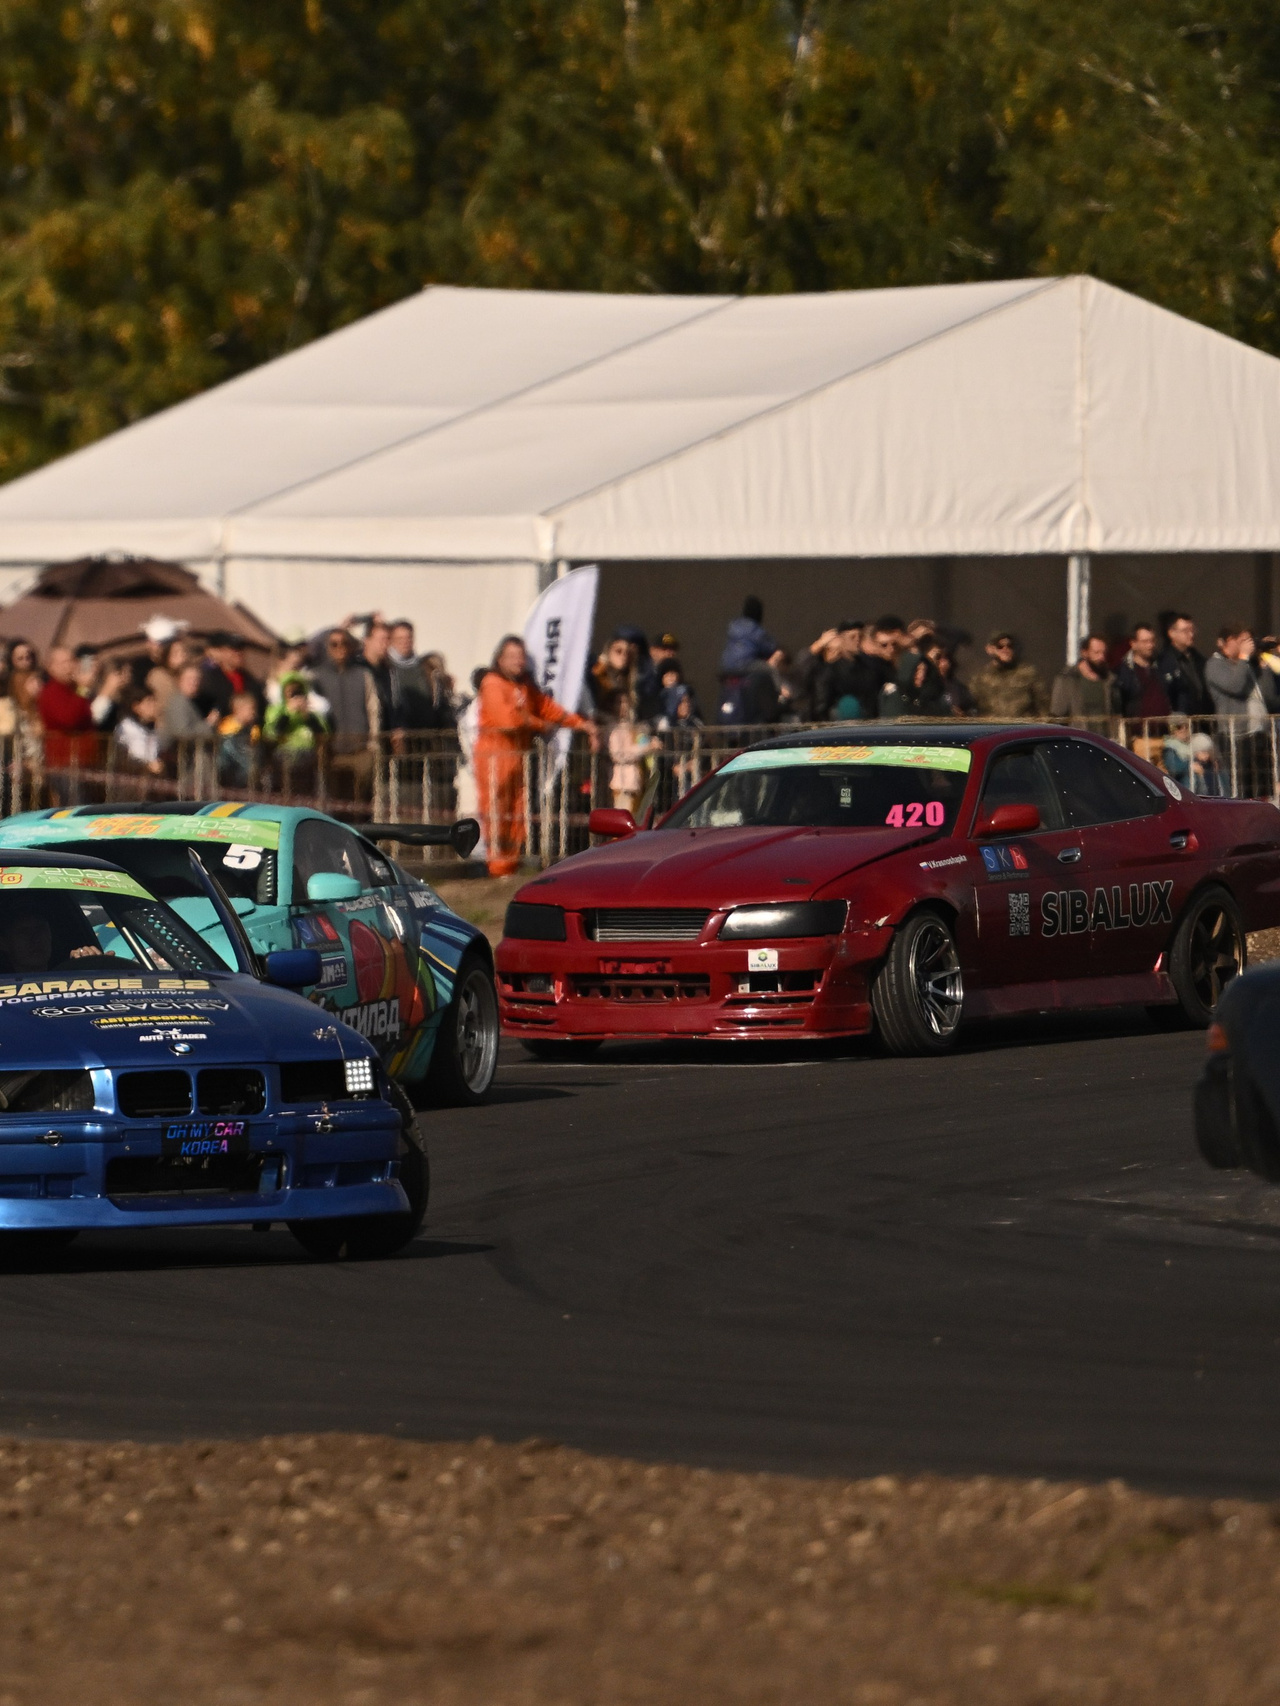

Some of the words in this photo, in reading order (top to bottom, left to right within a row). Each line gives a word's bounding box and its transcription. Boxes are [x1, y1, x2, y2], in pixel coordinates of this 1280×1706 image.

[885, 801, 944, 827] 420
[183, 819, 251, 832] 2024
[223, 843, 263, 870] 5
[983, 847, 1026, 870] SKR
[44, 868, 121, 882] 2024
[1040, 880, 1174, 938] SIBALUX
[158, 979, 211, 990] 22
[166, 1124, 188, 1139] OH
[189, 1122, 214, 1138] MY
[214, 1121, 245, 1137] CAR
[180, 1139, 228, 1156] KOREA
